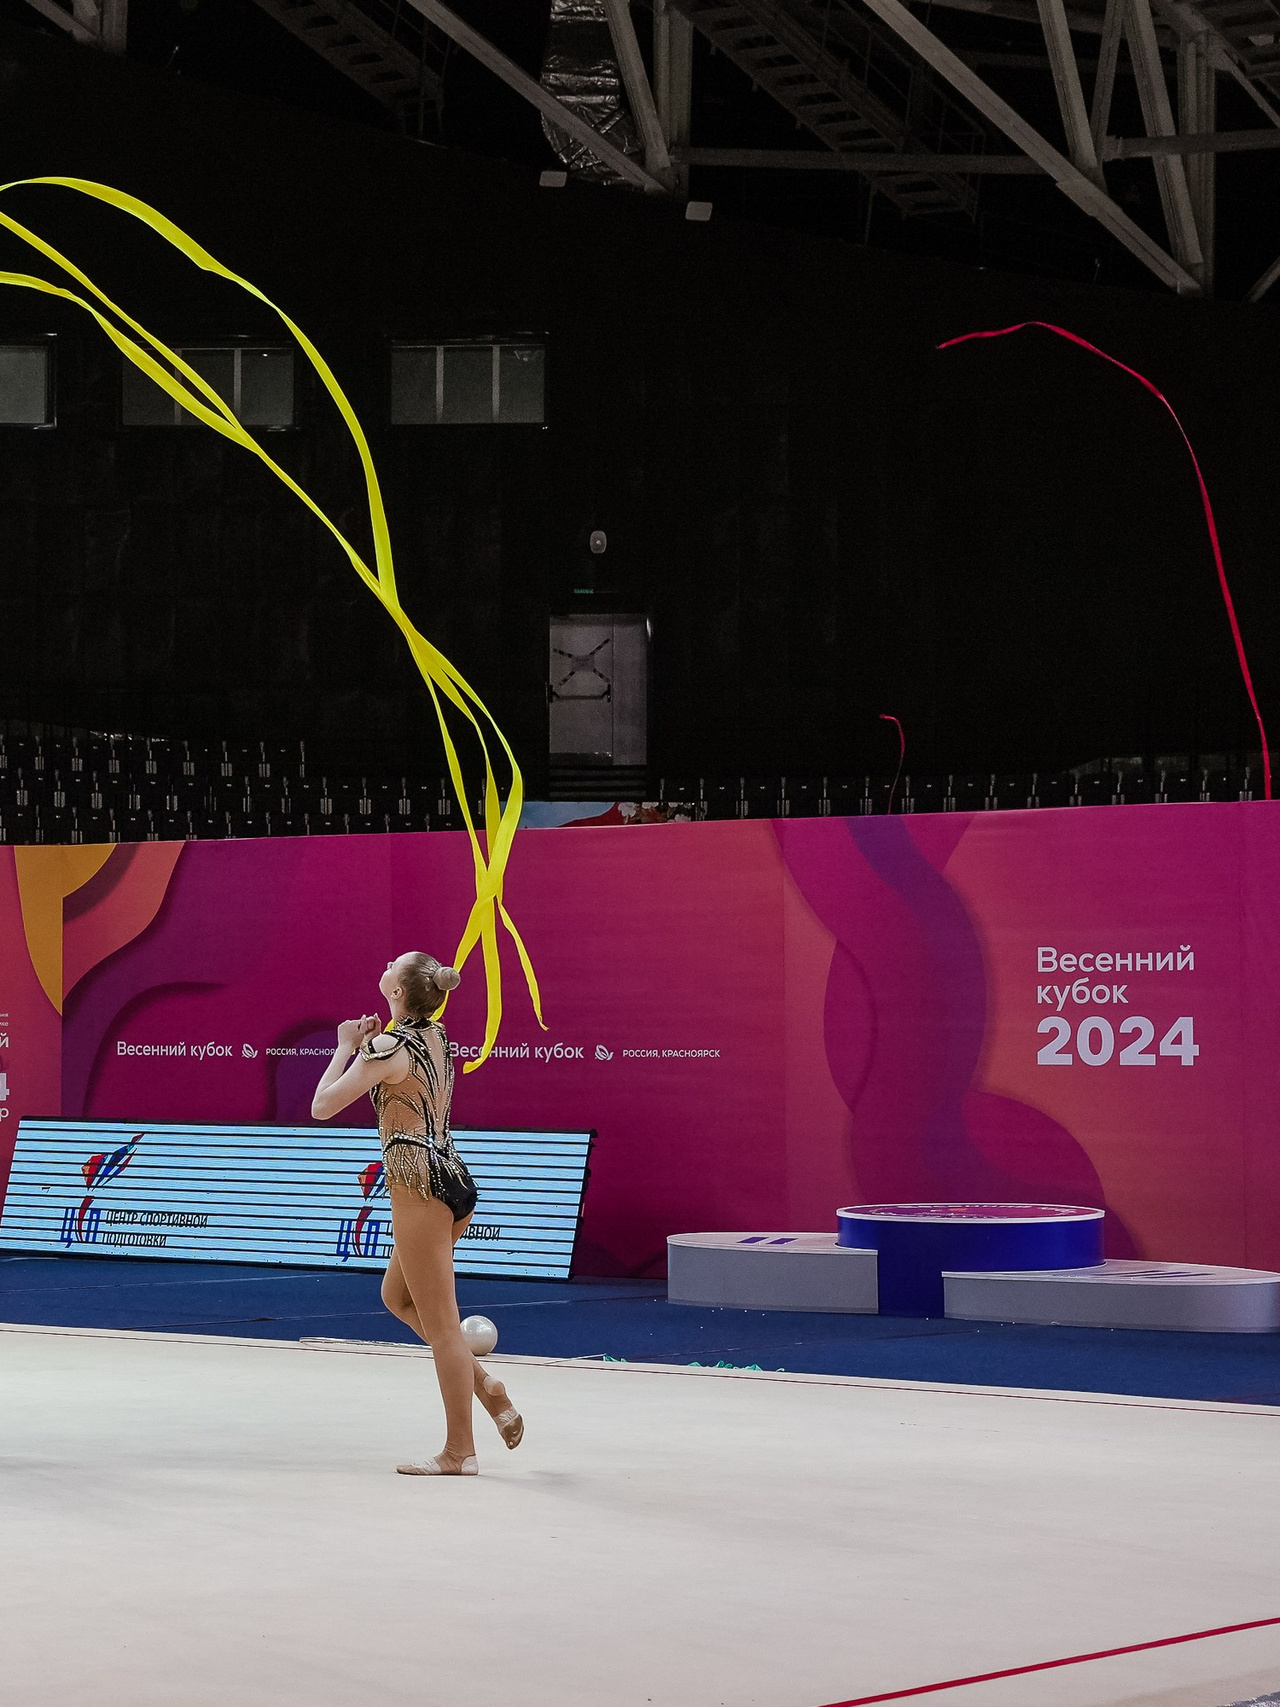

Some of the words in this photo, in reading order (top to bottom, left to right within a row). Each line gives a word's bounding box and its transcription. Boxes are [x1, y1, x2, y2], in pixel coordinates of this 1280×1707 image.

[1037, 944, 1195, 973] Весенний
[1037, 976, 1129, 1012] кубок
[117, 1040, 186, 1056] Весенний
[190, 1041, 233, 1060] кубок
[299, 1048, 336, 1056] КРАСНОЯ
[534, 1042, 584, 1063] кубок
[662, 1049, 720, 1058] КРАСНОЯРСК
[1036, 1015, 1200, 1067] 2024
